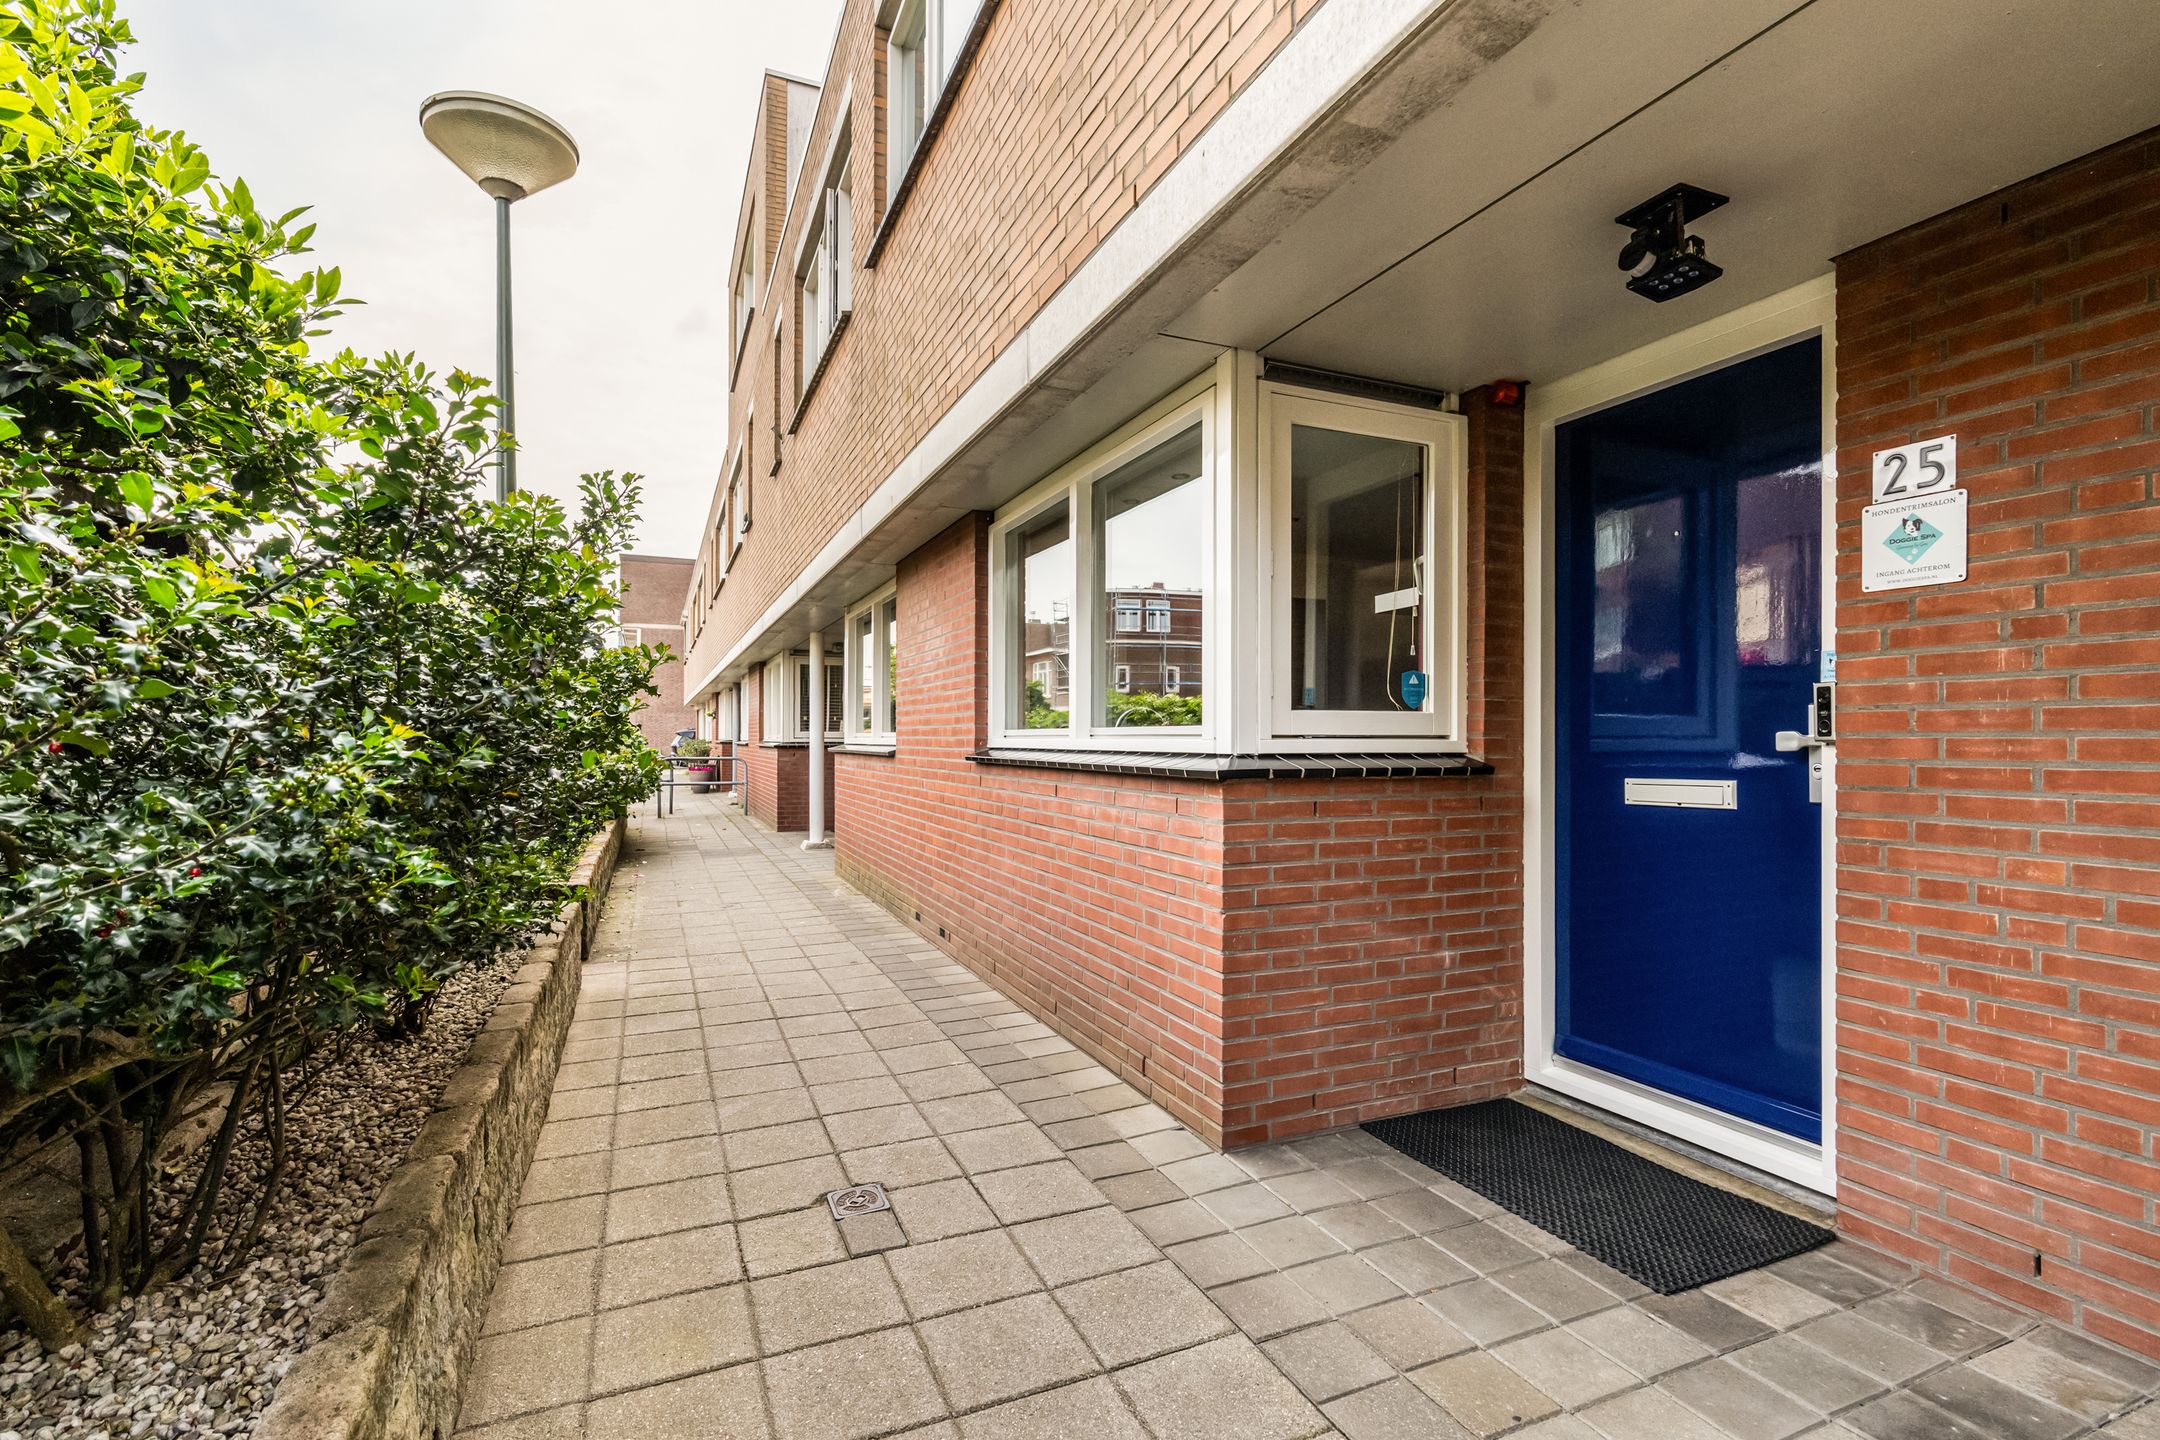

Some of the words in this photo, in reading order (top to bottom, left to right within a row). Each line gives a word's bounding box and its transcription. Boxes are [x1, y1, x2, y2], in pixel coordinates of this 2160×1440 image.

[1882, 443, 1946, 496] 25
[1871, 497, 1957, 517] HONDENTRIMSALON
[1889, 536, 1919, 545] DOGGIE
[1876, 569, 1906, 578] INGANG
[1906, 563, 1951, 575] ACHTEROM
